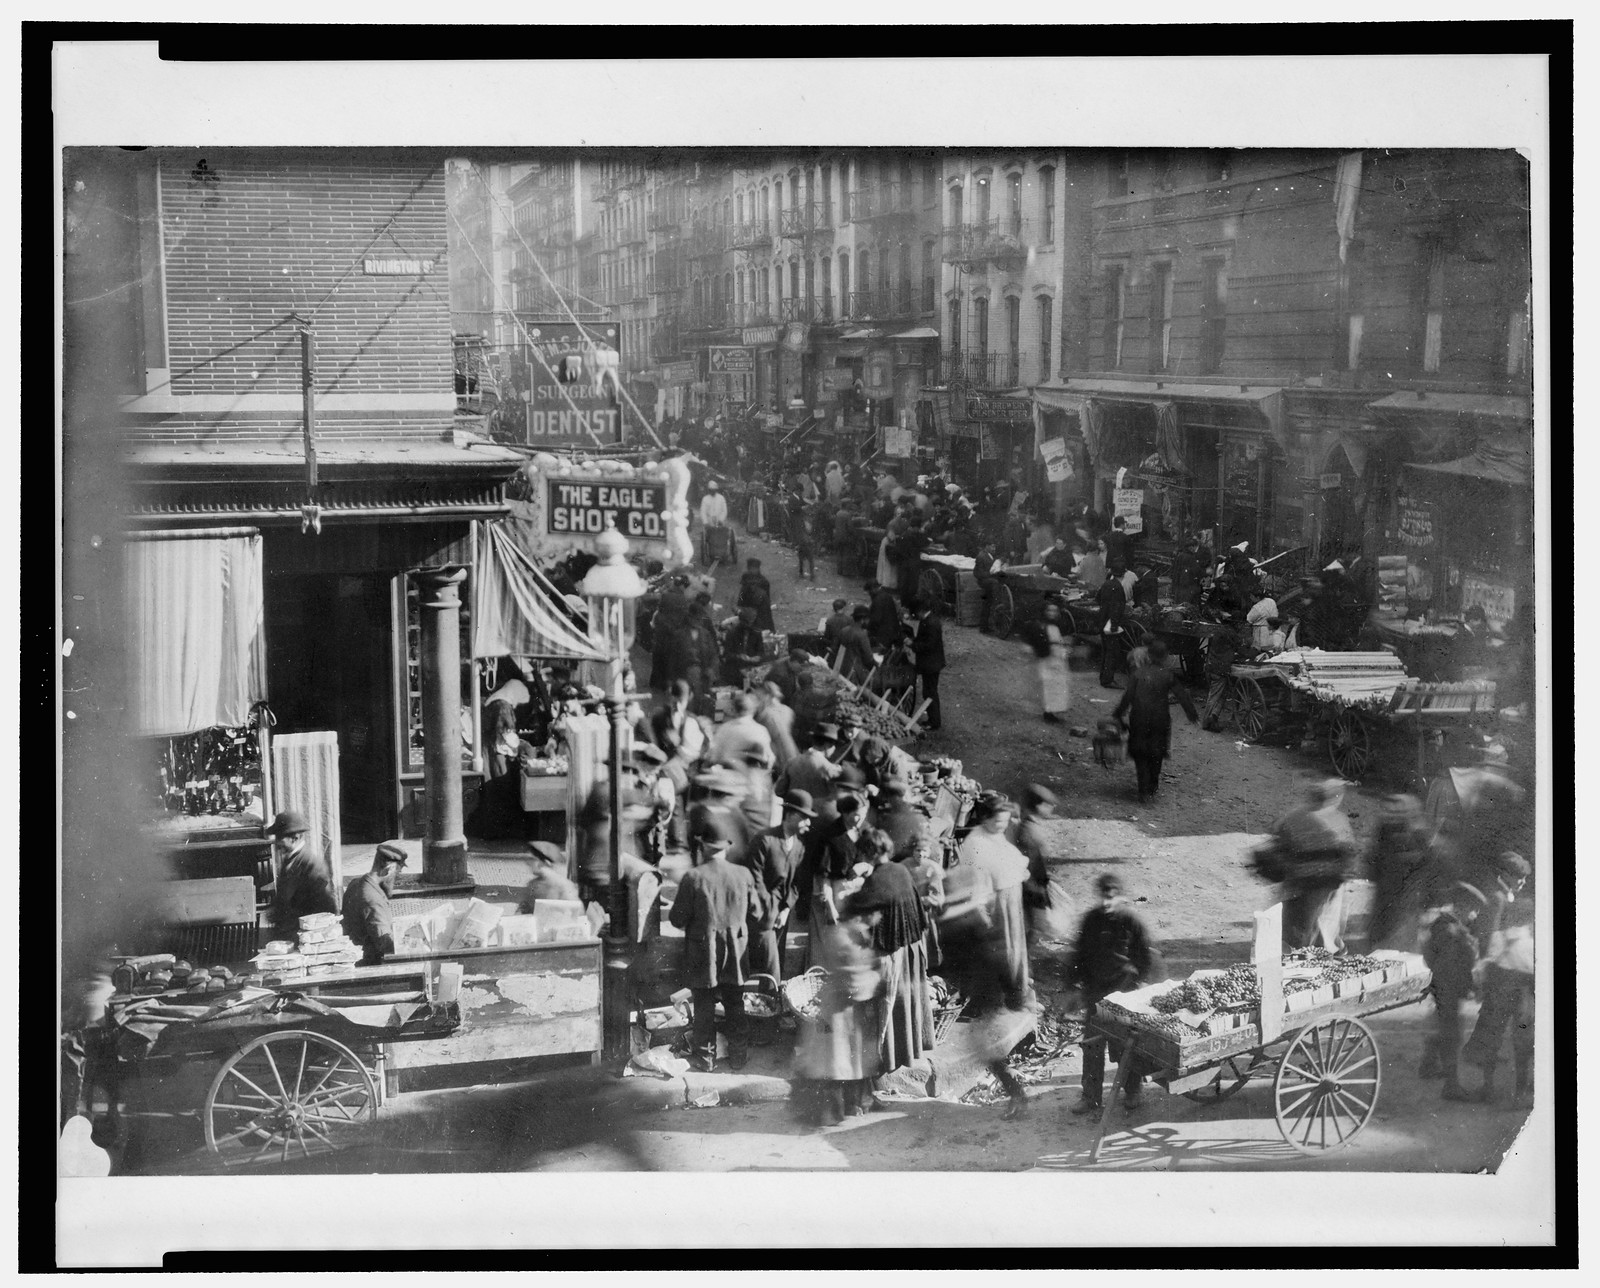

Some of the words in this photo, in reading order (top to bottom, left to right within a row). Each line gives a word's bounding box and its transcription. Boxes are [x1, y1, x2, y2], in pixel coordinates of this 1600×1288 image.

[365, 260, 420, 274] RIVINGTON
[742, 328, 777, 345] LAUNDRY
[537, 385, 609, 399] SURGEON
[533, 410, 617, 435] DENTIST
[559, 485, 592, 506] THE
[599, 487, 654, 509] EAGLE
[628, 511, 665, 536] CO.
